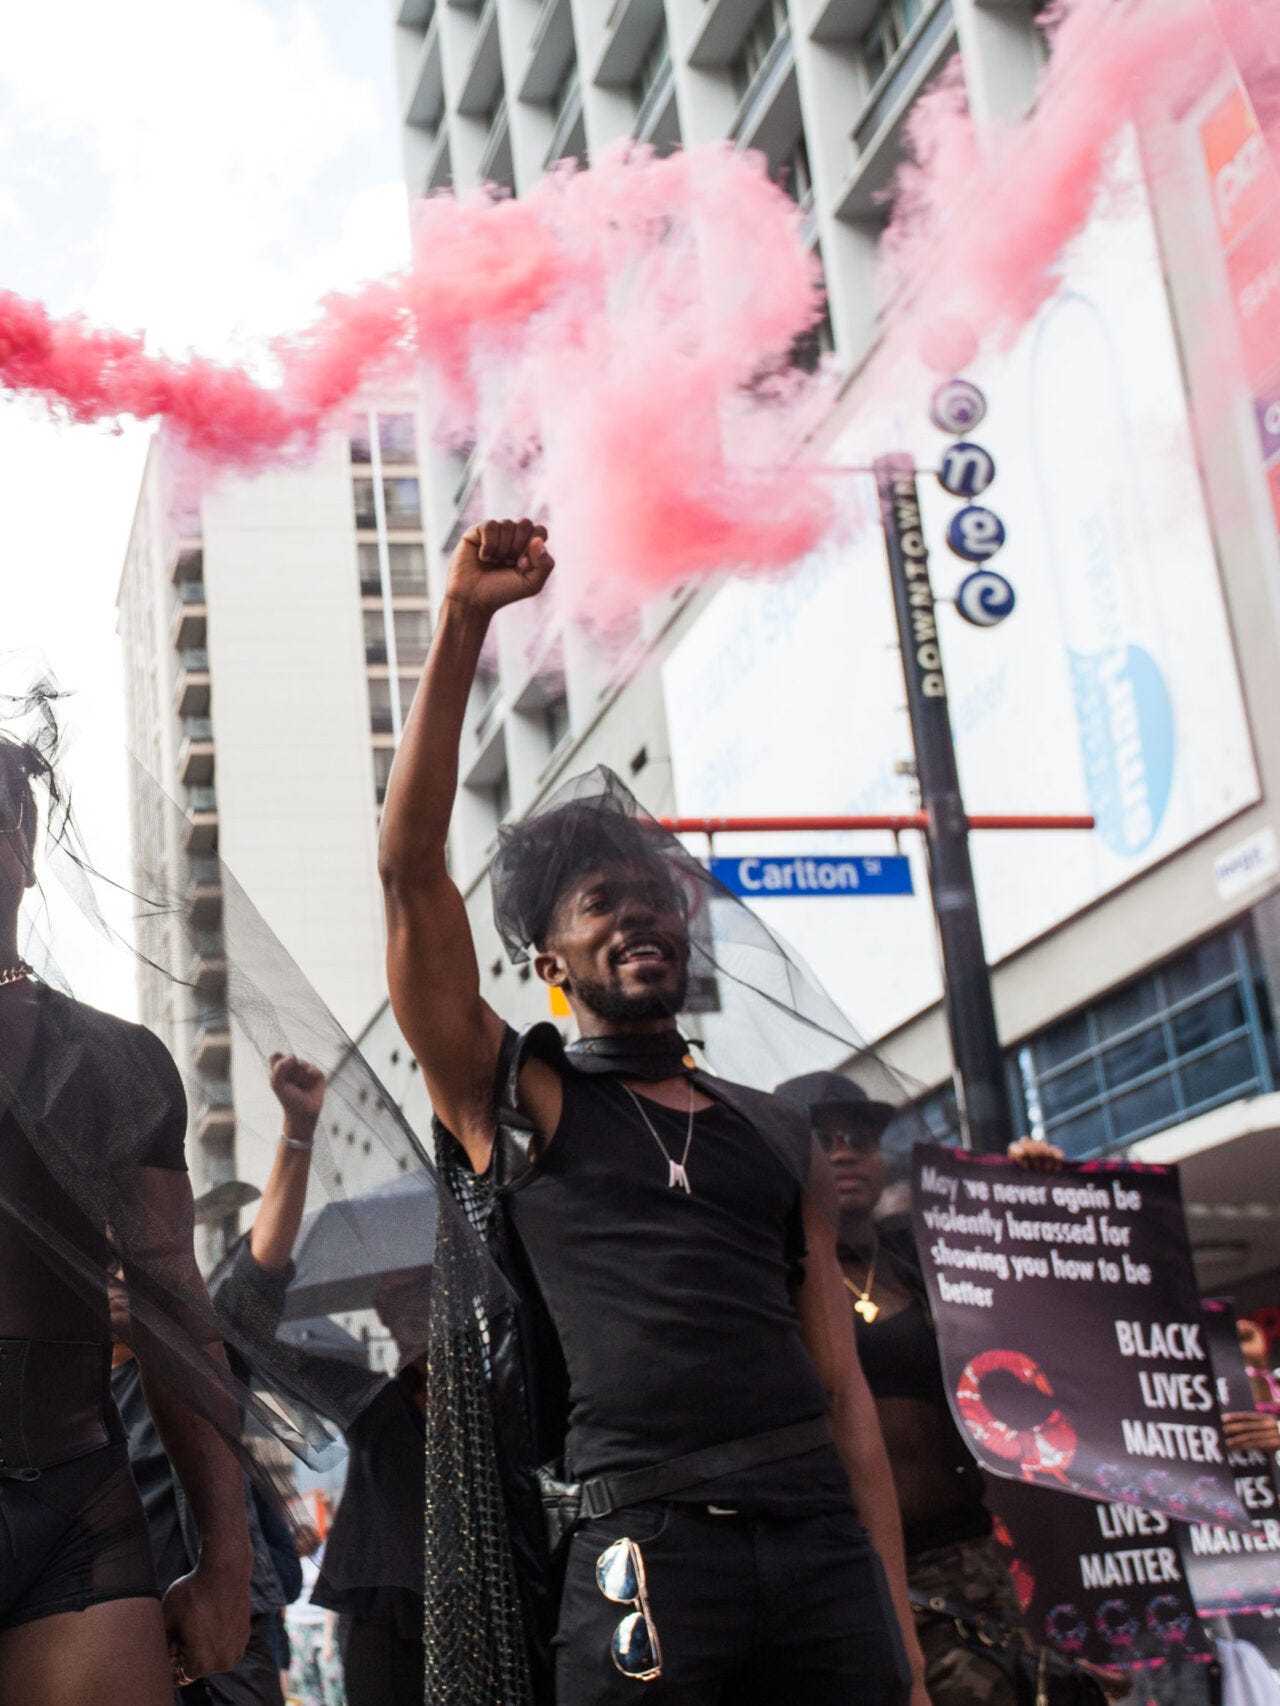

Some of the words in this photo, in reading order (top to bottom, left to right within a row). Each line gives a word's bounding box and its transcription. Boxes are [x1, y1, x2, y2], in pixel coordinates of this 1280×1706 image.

[929, 380, 1012, 627] onge
[892, 471, 947, 697] DOWNTOWN
[737, 858, 860, 891] Carlton
[921, 1165, 959, 1203] May
[993, 1183, 1047, 1206] never
[1052, 1183, 1111, 1214] again
[1112, 1179, 1142, 1212] be
[923, 1204, 1004, 1244] violently
[1005, 1210, 1098, 1246] harassed
[1099, 1216, 1131, 1247] for
[931, 1237, 1010, 1281] showing
[1011, 1255, 1050, 1282] you
[1050, 1249, 1095, 1281] how
[1097, 1257, 1121, 1284] to
[1122, 1253, 1152, 1285] be
[937, 1272, 995, 1308] better
[1114, 1320, 1207, 1361] BLACK
[1138, 1371, 1215, 1413] LIVES
[1121, 1419, 1224, 1464] MATTER
[1096, 1503, 1170, 1540] LIVES
[1079, 1547, 1182, 1591] MATTER
